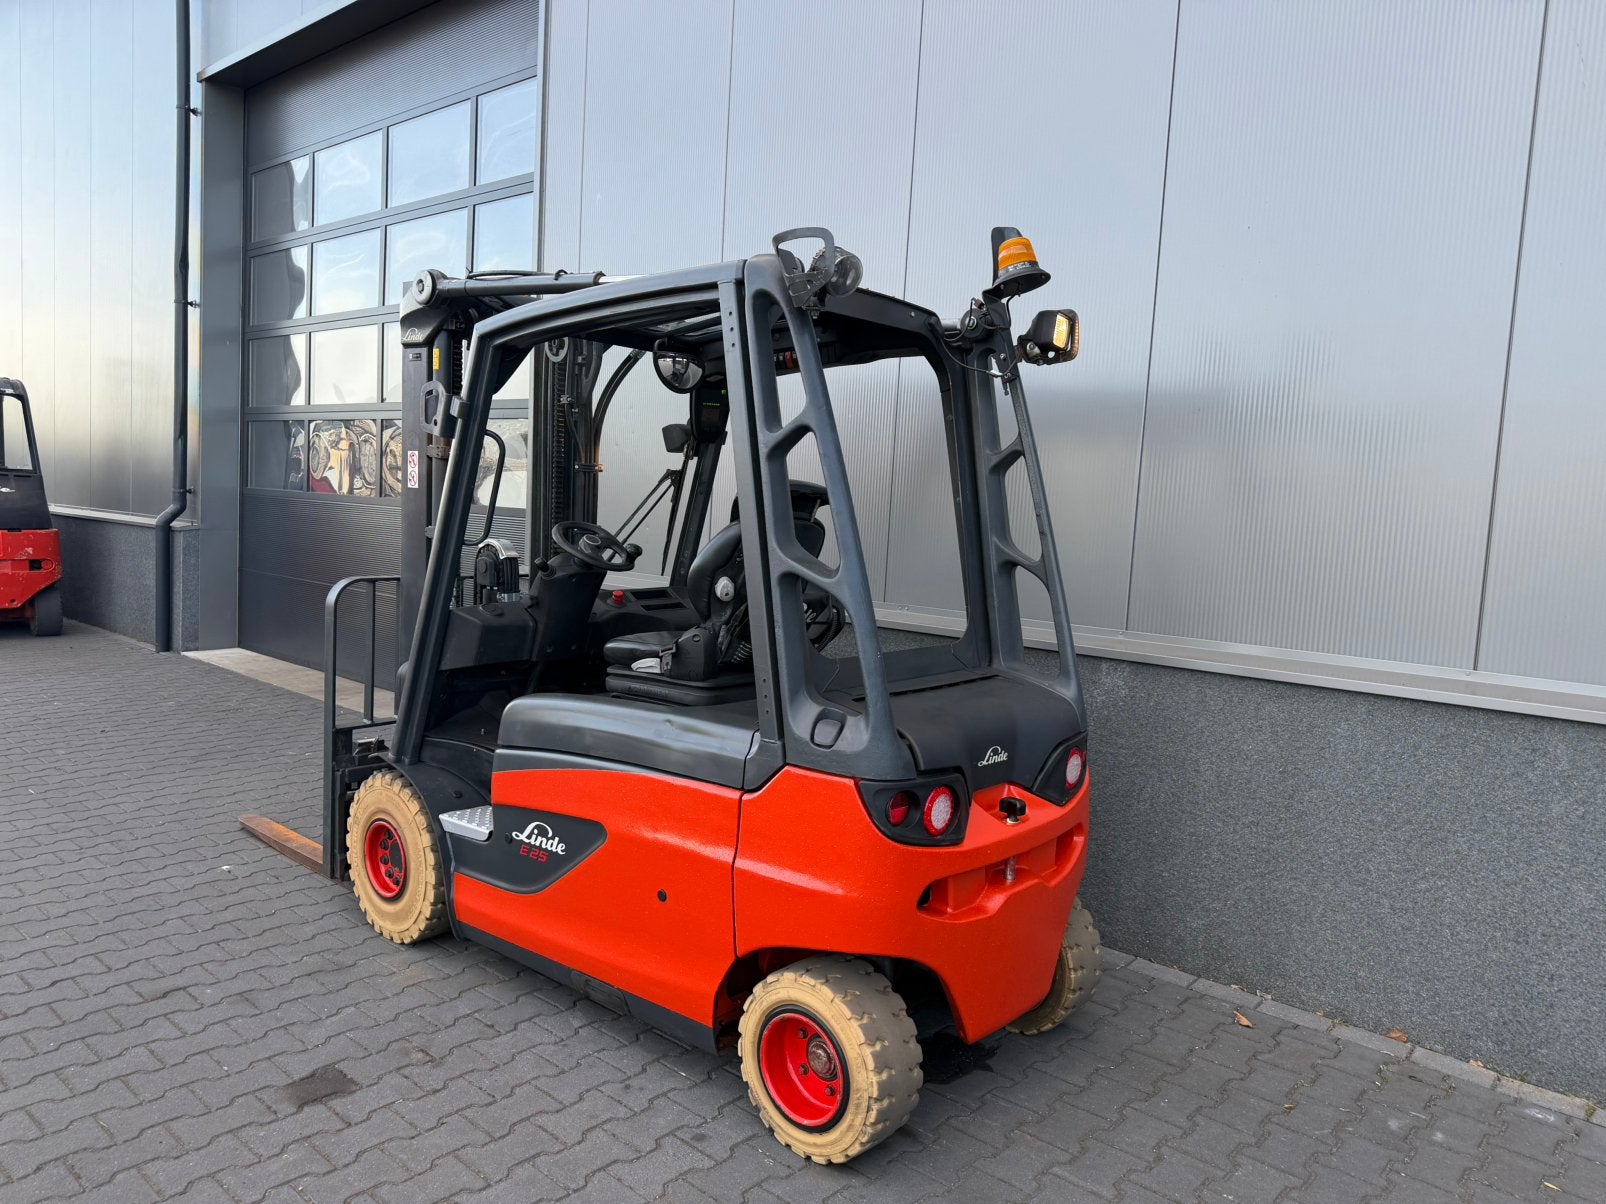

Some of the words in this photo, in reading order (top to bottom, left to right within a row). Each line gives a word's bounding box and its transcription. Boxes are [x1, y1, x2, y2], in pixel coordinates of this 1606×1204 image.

[978, 746, 1008, 767] Linde
[511, 821, 566, 855] Linde
[520, 845, 530, 857] E
[530, 848, 549, 863] 25
